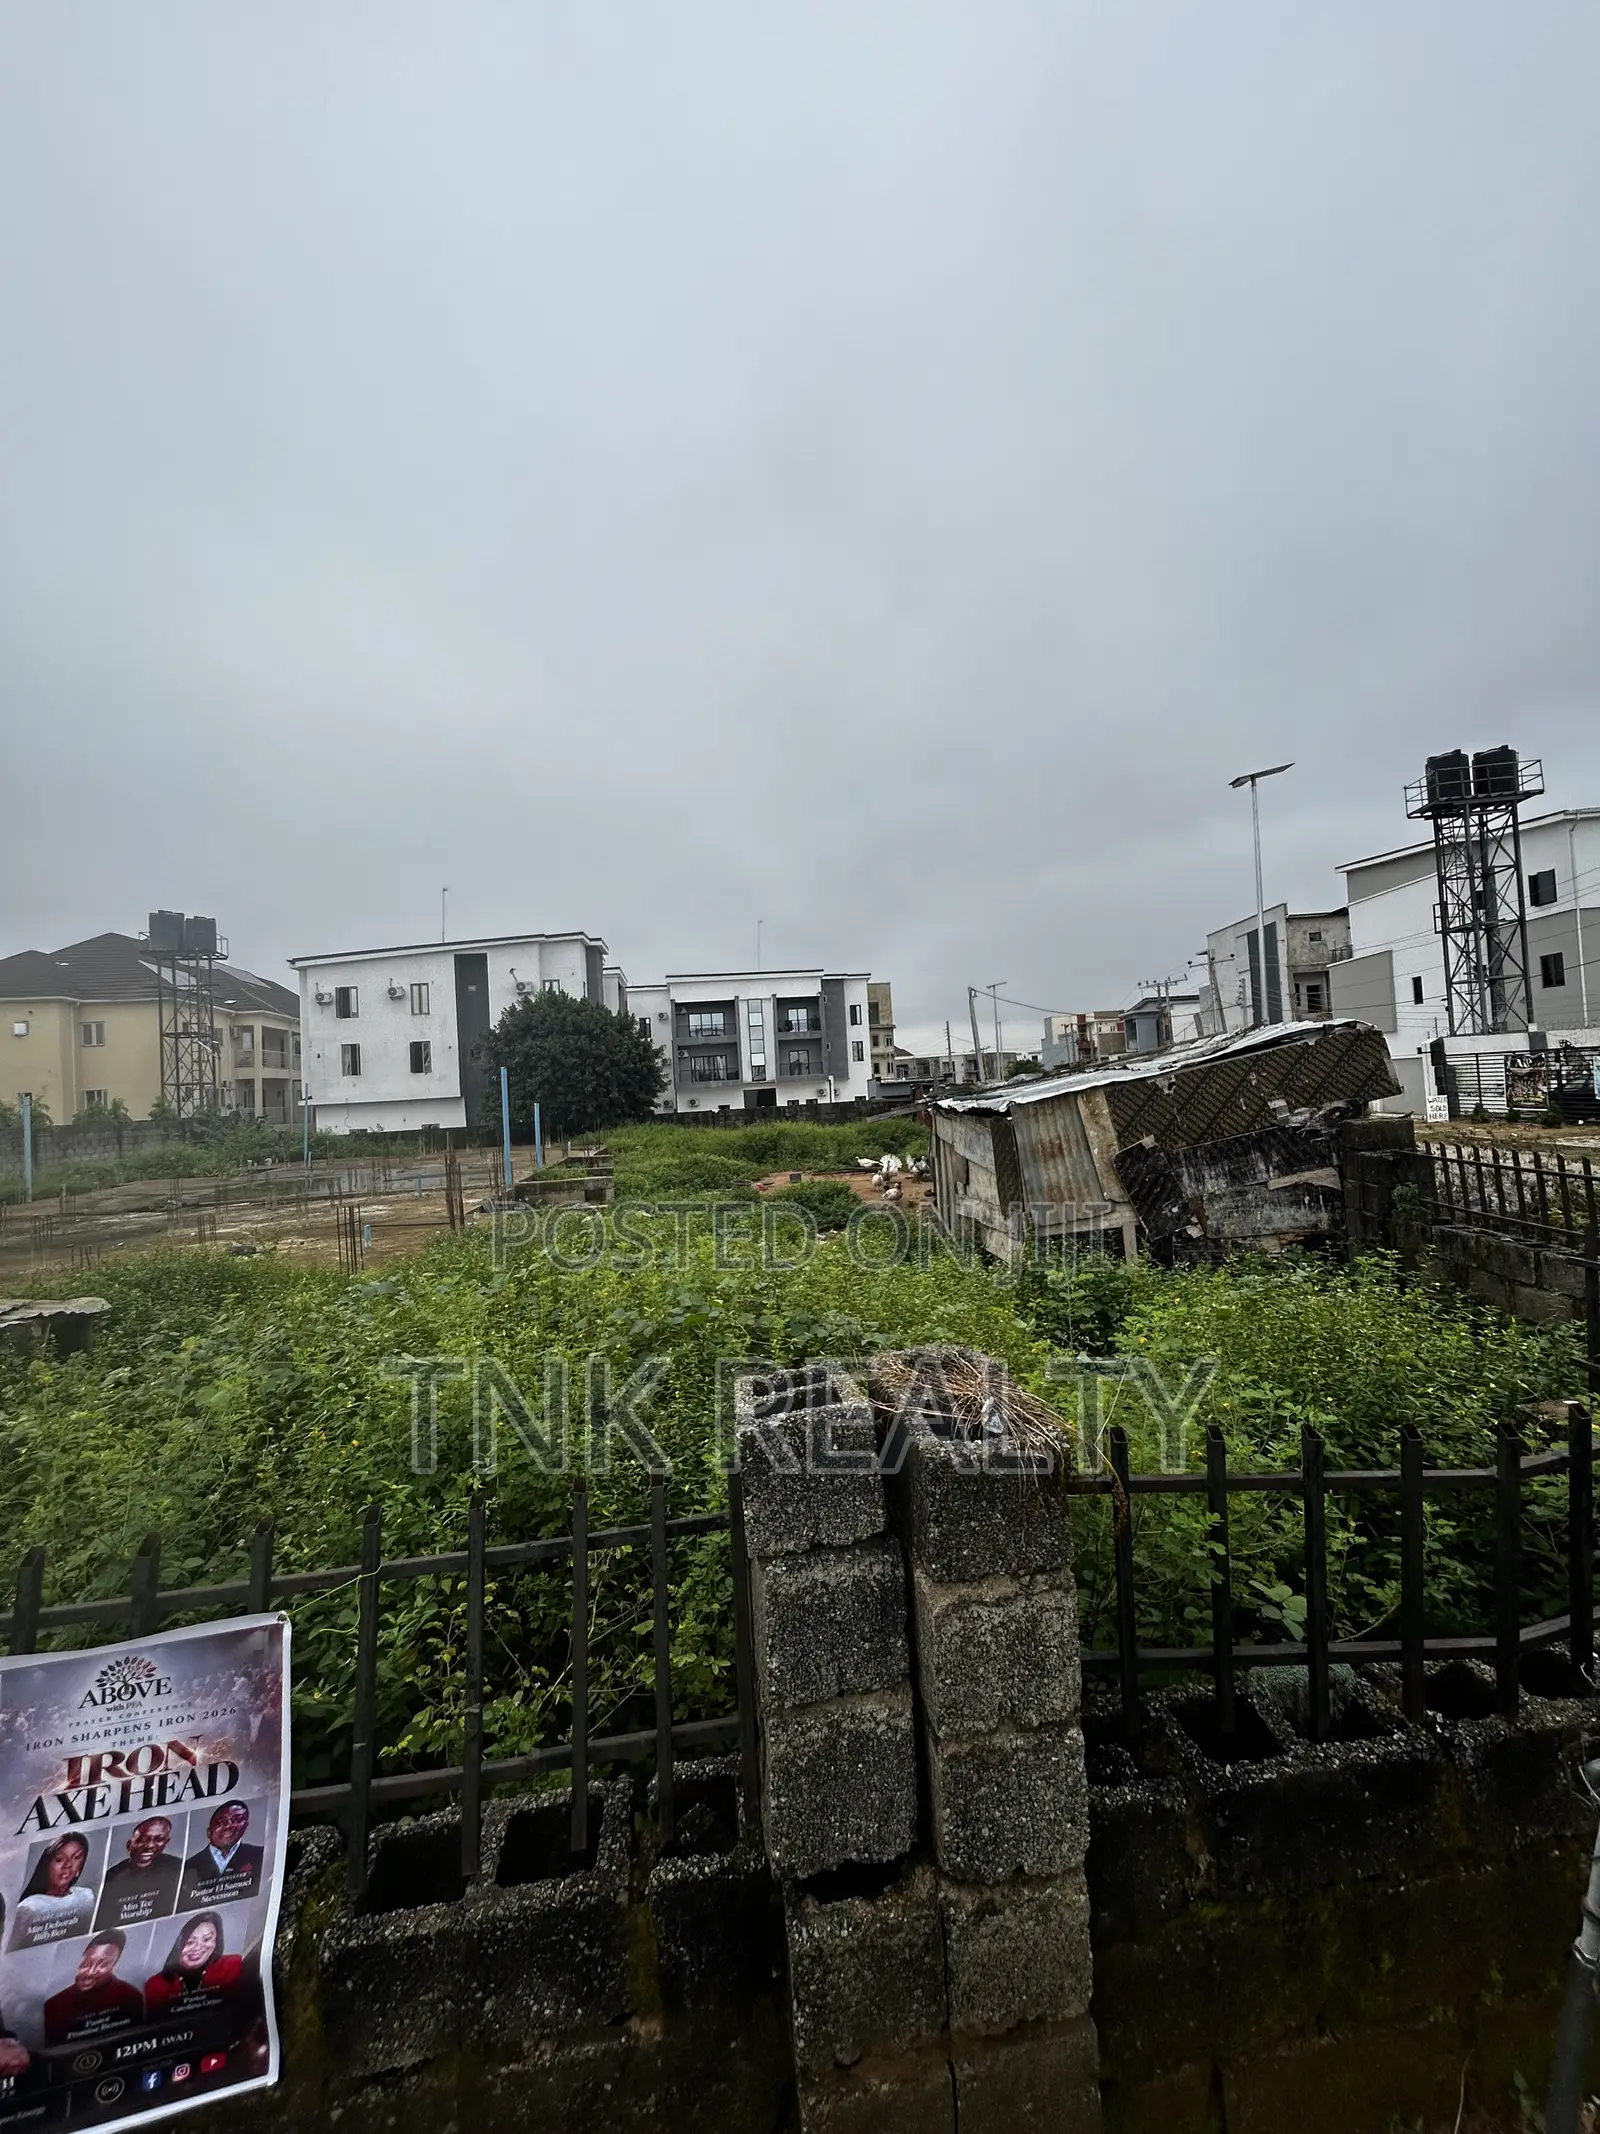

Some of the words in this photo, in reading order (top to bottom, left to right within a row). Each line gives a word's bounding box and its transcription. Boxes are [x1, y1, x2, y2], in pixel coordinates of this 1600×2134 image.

[1429, 1112, 1448, 1120] HERE
[78, 1676, 172, 1709] ABOVE
[106, 1703, 124, 1713] with
[25, 1737, 65, 1751] IRON
[71, 1722, 151, 1744] SHARPENS
[159, 1713, 196, 1728] IRON
[202, 1707, 237, 1720] 2026
[68, 1715, 112, 1728] PRAYER
[62, 1735, 204, 1791] IRON
[190, 1886, 214, 1898] Pastor
[224, 1878, 252, 1891] Samuel
[201, 1890, 239, 1903] Stevenson
[120, 1907, 153, 1920] Worship
[44, 1915, 79, 1931] Deborah
[116, 2037, 158, 2059] 12PM
[161, 2030, 194, 2046] (WAT)
